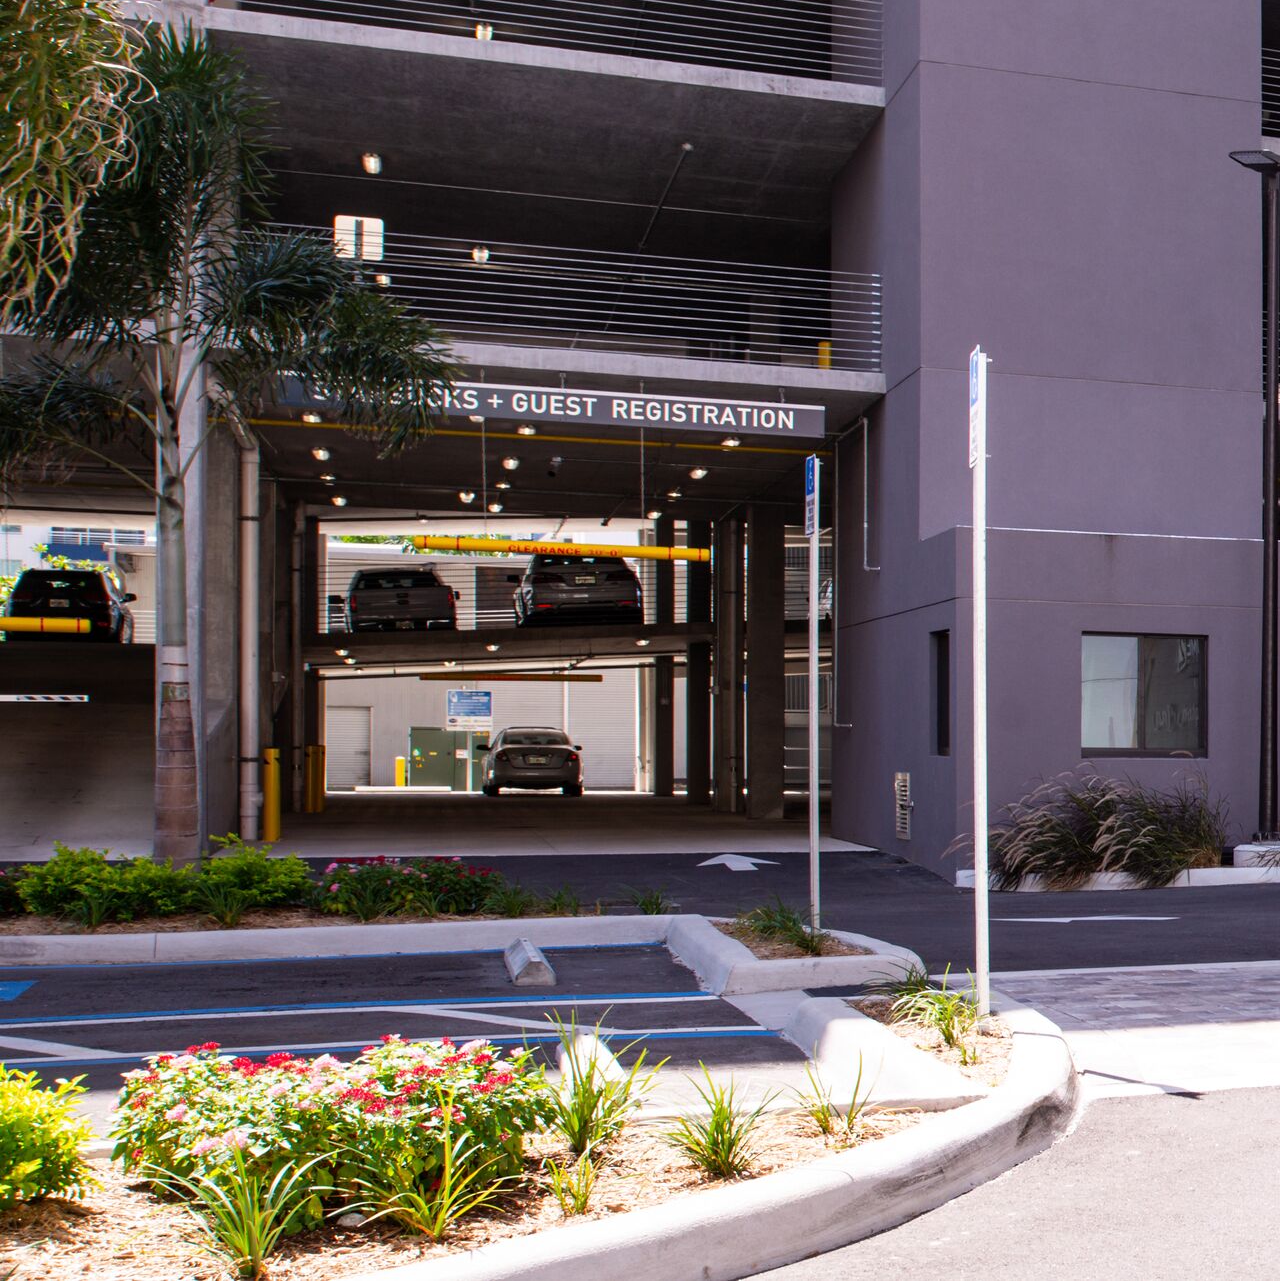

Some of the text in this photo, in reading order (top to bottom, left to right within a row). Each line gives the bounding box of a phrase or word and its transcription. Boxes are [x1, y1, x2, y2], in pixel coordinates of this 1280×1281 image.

[511, 393, 598, 417] GUEST
[611, 399, 795, 430] REGISTRATION
[507, 544, 582, 557] CLEARANCE
